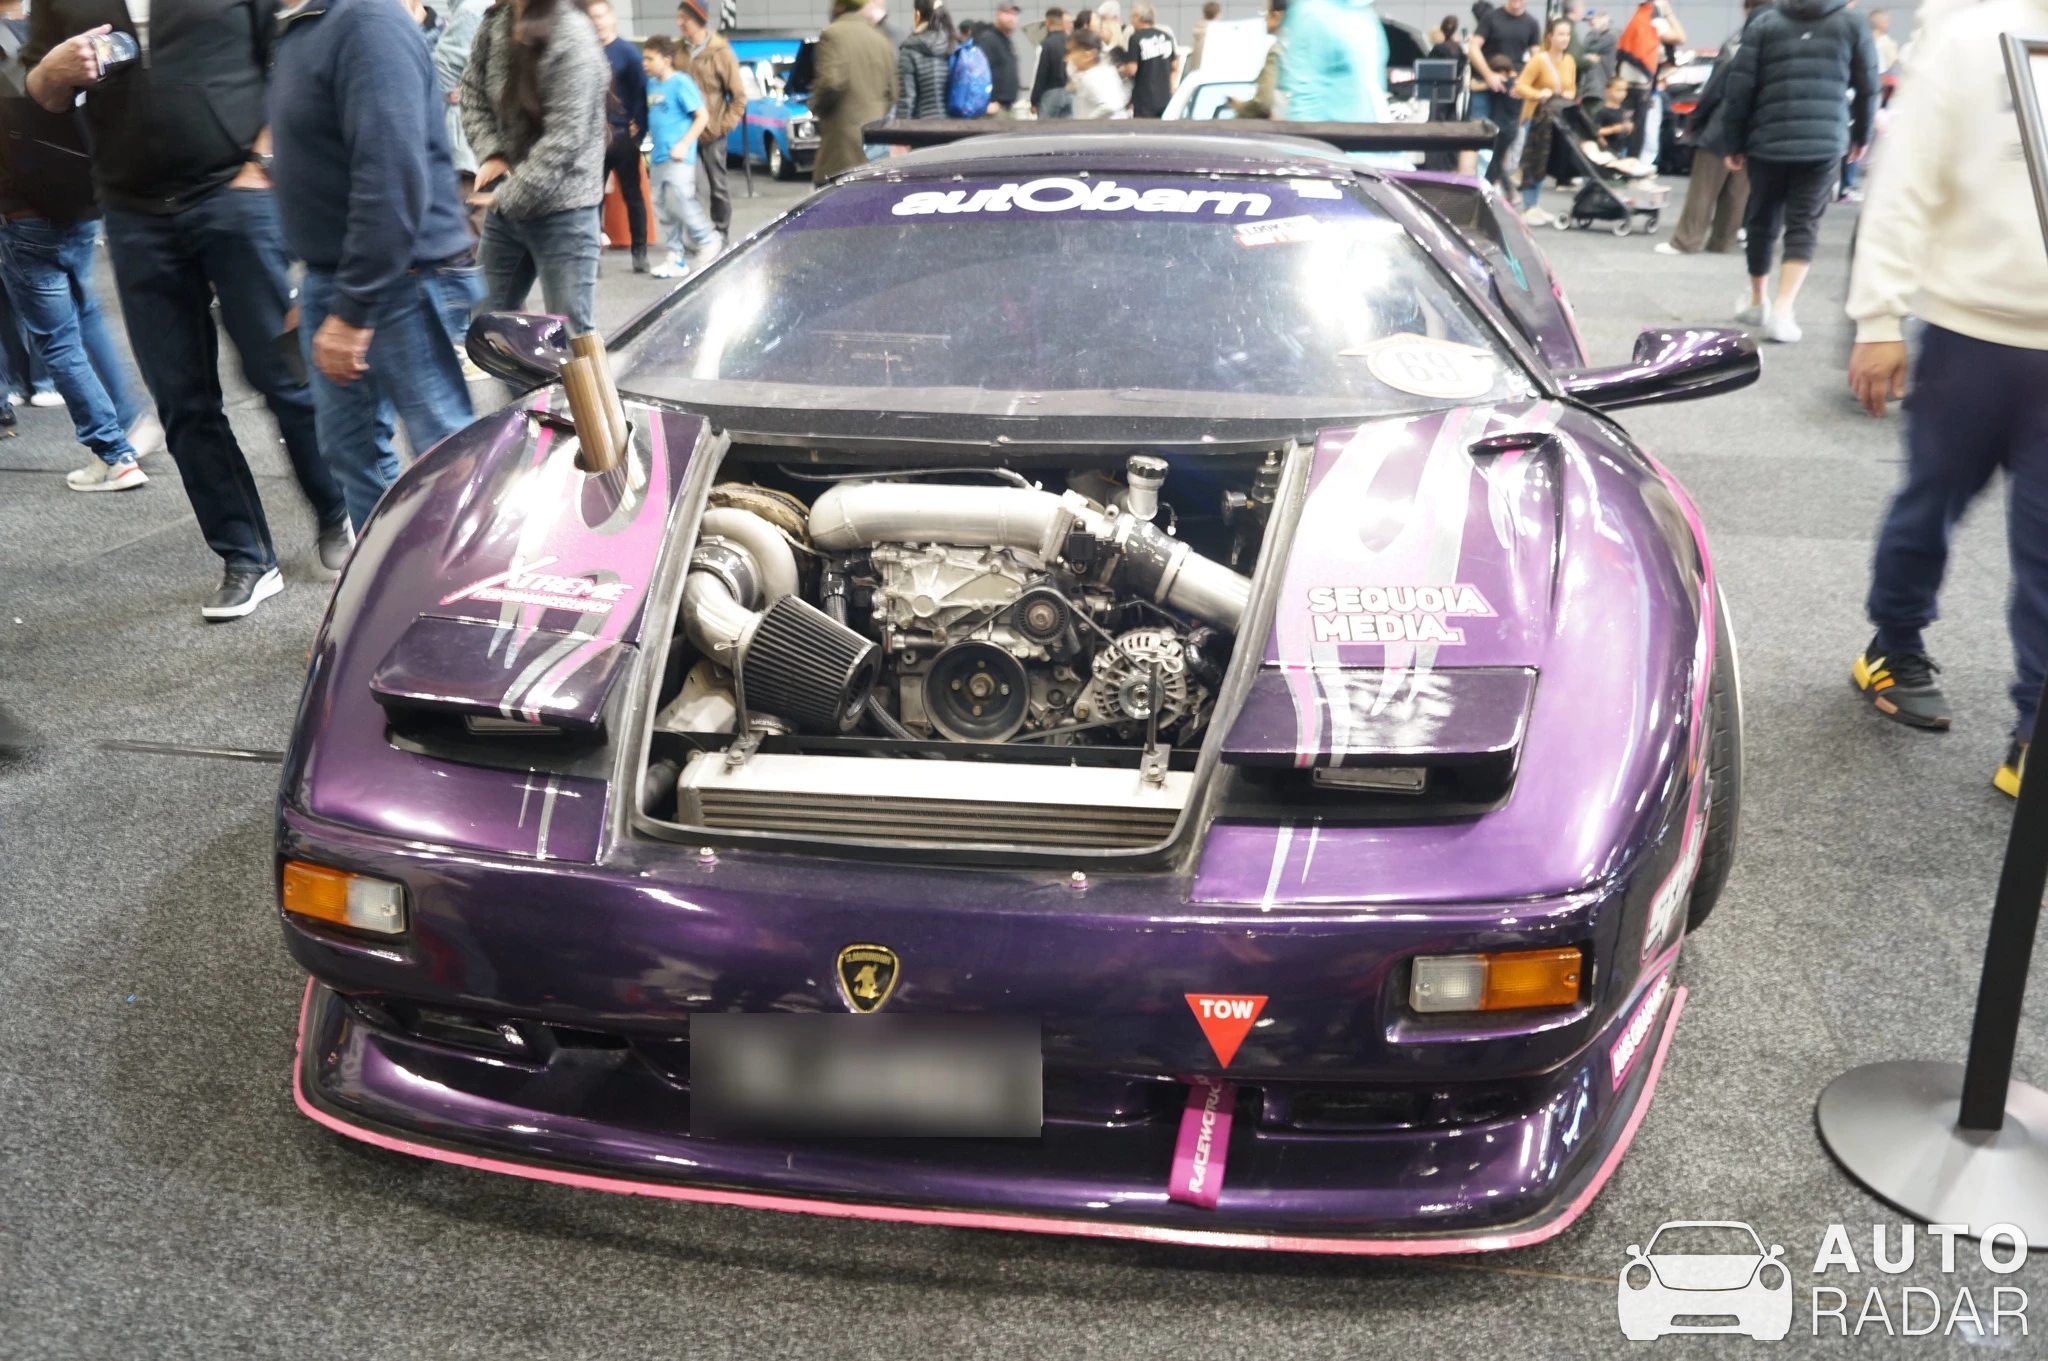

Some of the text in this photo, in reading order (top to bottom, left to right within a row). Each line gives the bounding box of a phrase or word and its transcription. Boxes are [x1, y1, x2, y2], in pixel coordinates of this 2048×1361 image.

[1395, 351, 1462, 382] 69
[1308, 586, 1490, 614] SEQUOIA
[1199, 1000, 1254, 1019] TOW
